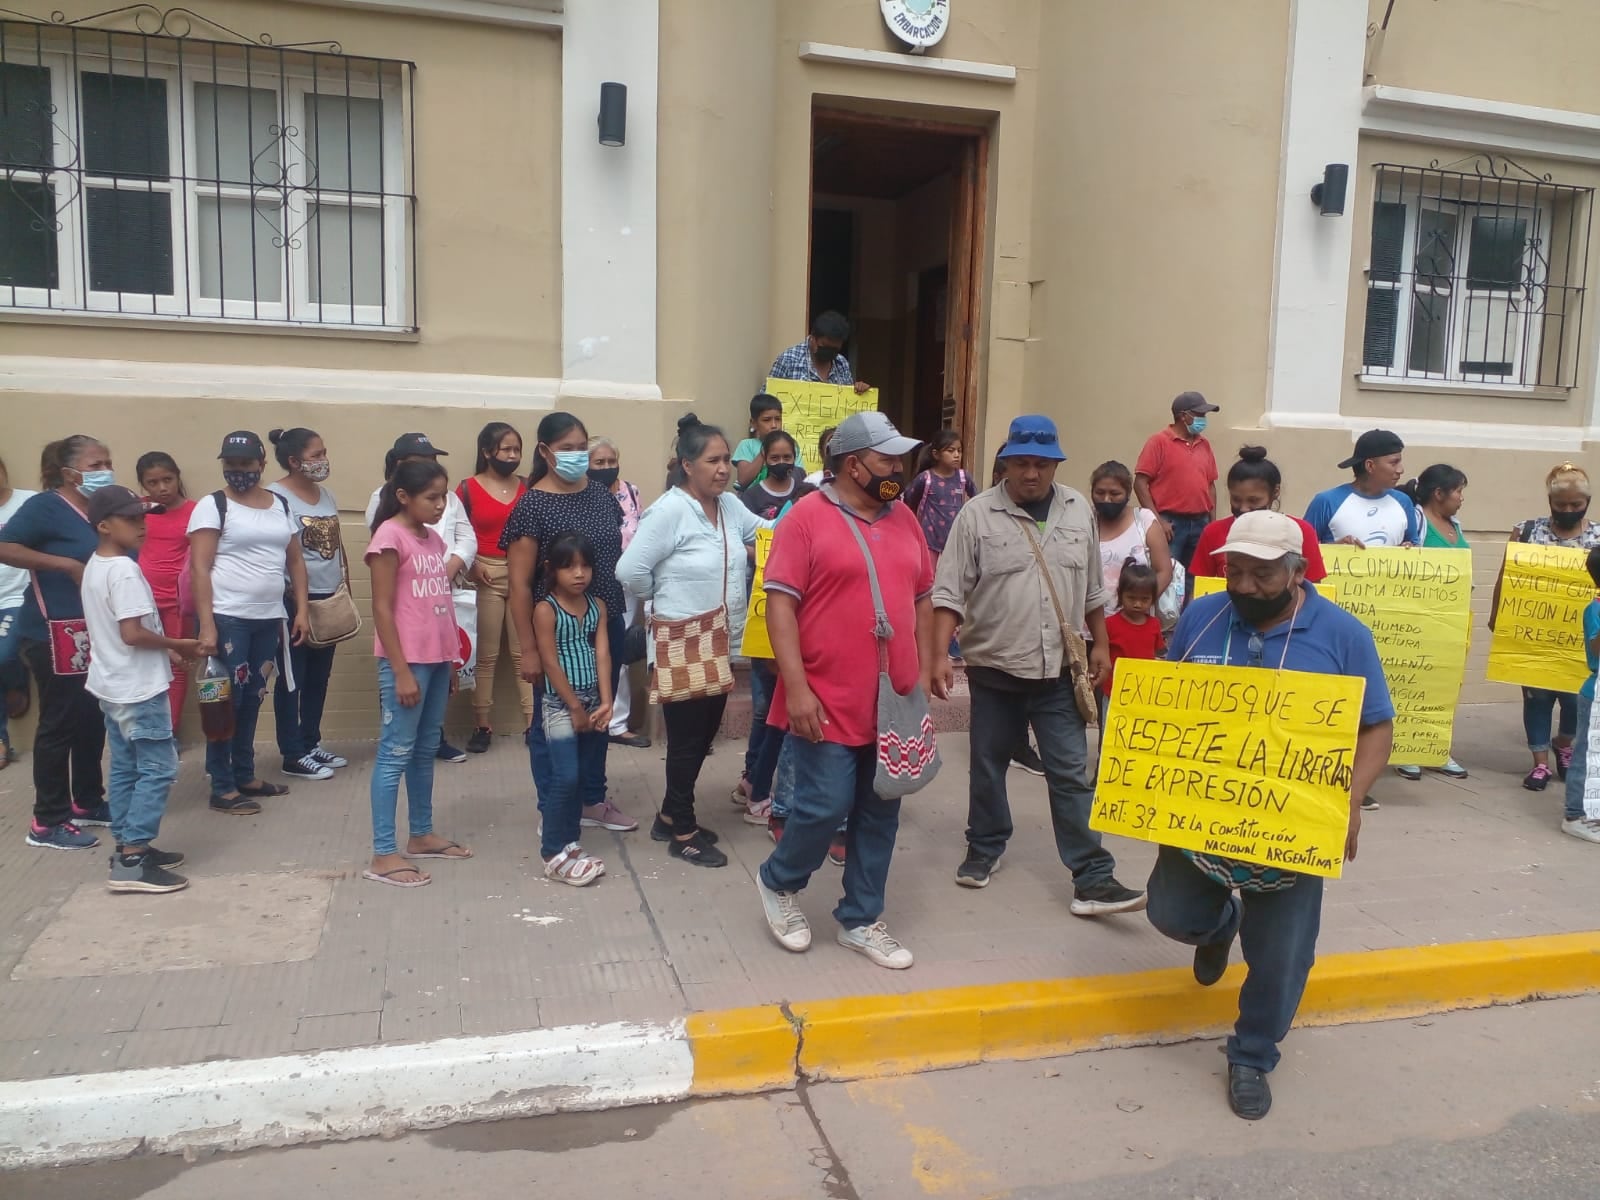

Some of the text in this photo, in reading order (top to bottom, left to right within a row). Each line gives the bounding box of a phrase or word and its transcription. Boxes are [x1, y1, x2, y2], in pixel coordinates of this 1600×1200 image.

[893, 12, 943, 39] EMBARCACION
[776, 391, 878, 419] EXIGIMO
[1347, 556, 1460, 585] COMUNIDAD
[1514, 552, 1586, 573] COMUN
[1343, 581, 1386, 597] LOMA
[1567, 581, 1598, 600] GUA
[1501, 596, 1578, 623] MISION LA
[1371, 620, 1421, 635] HUMEDO
[1389, 686, 1425, 701] AGUA
[1305, 698, 1347, 726] SE
[1113, 714, 1353, 794] RESPETE LA LIBERTAD
[1103, 757, 1290, 813] DE EXPRESIÓN
[1132, 804, 1158, 831] 32
[1167, 812, 1187, 830] DE
[1189, 813, 1203, 832] LA
[1204, 839, 1257, 856] NACIONAL
